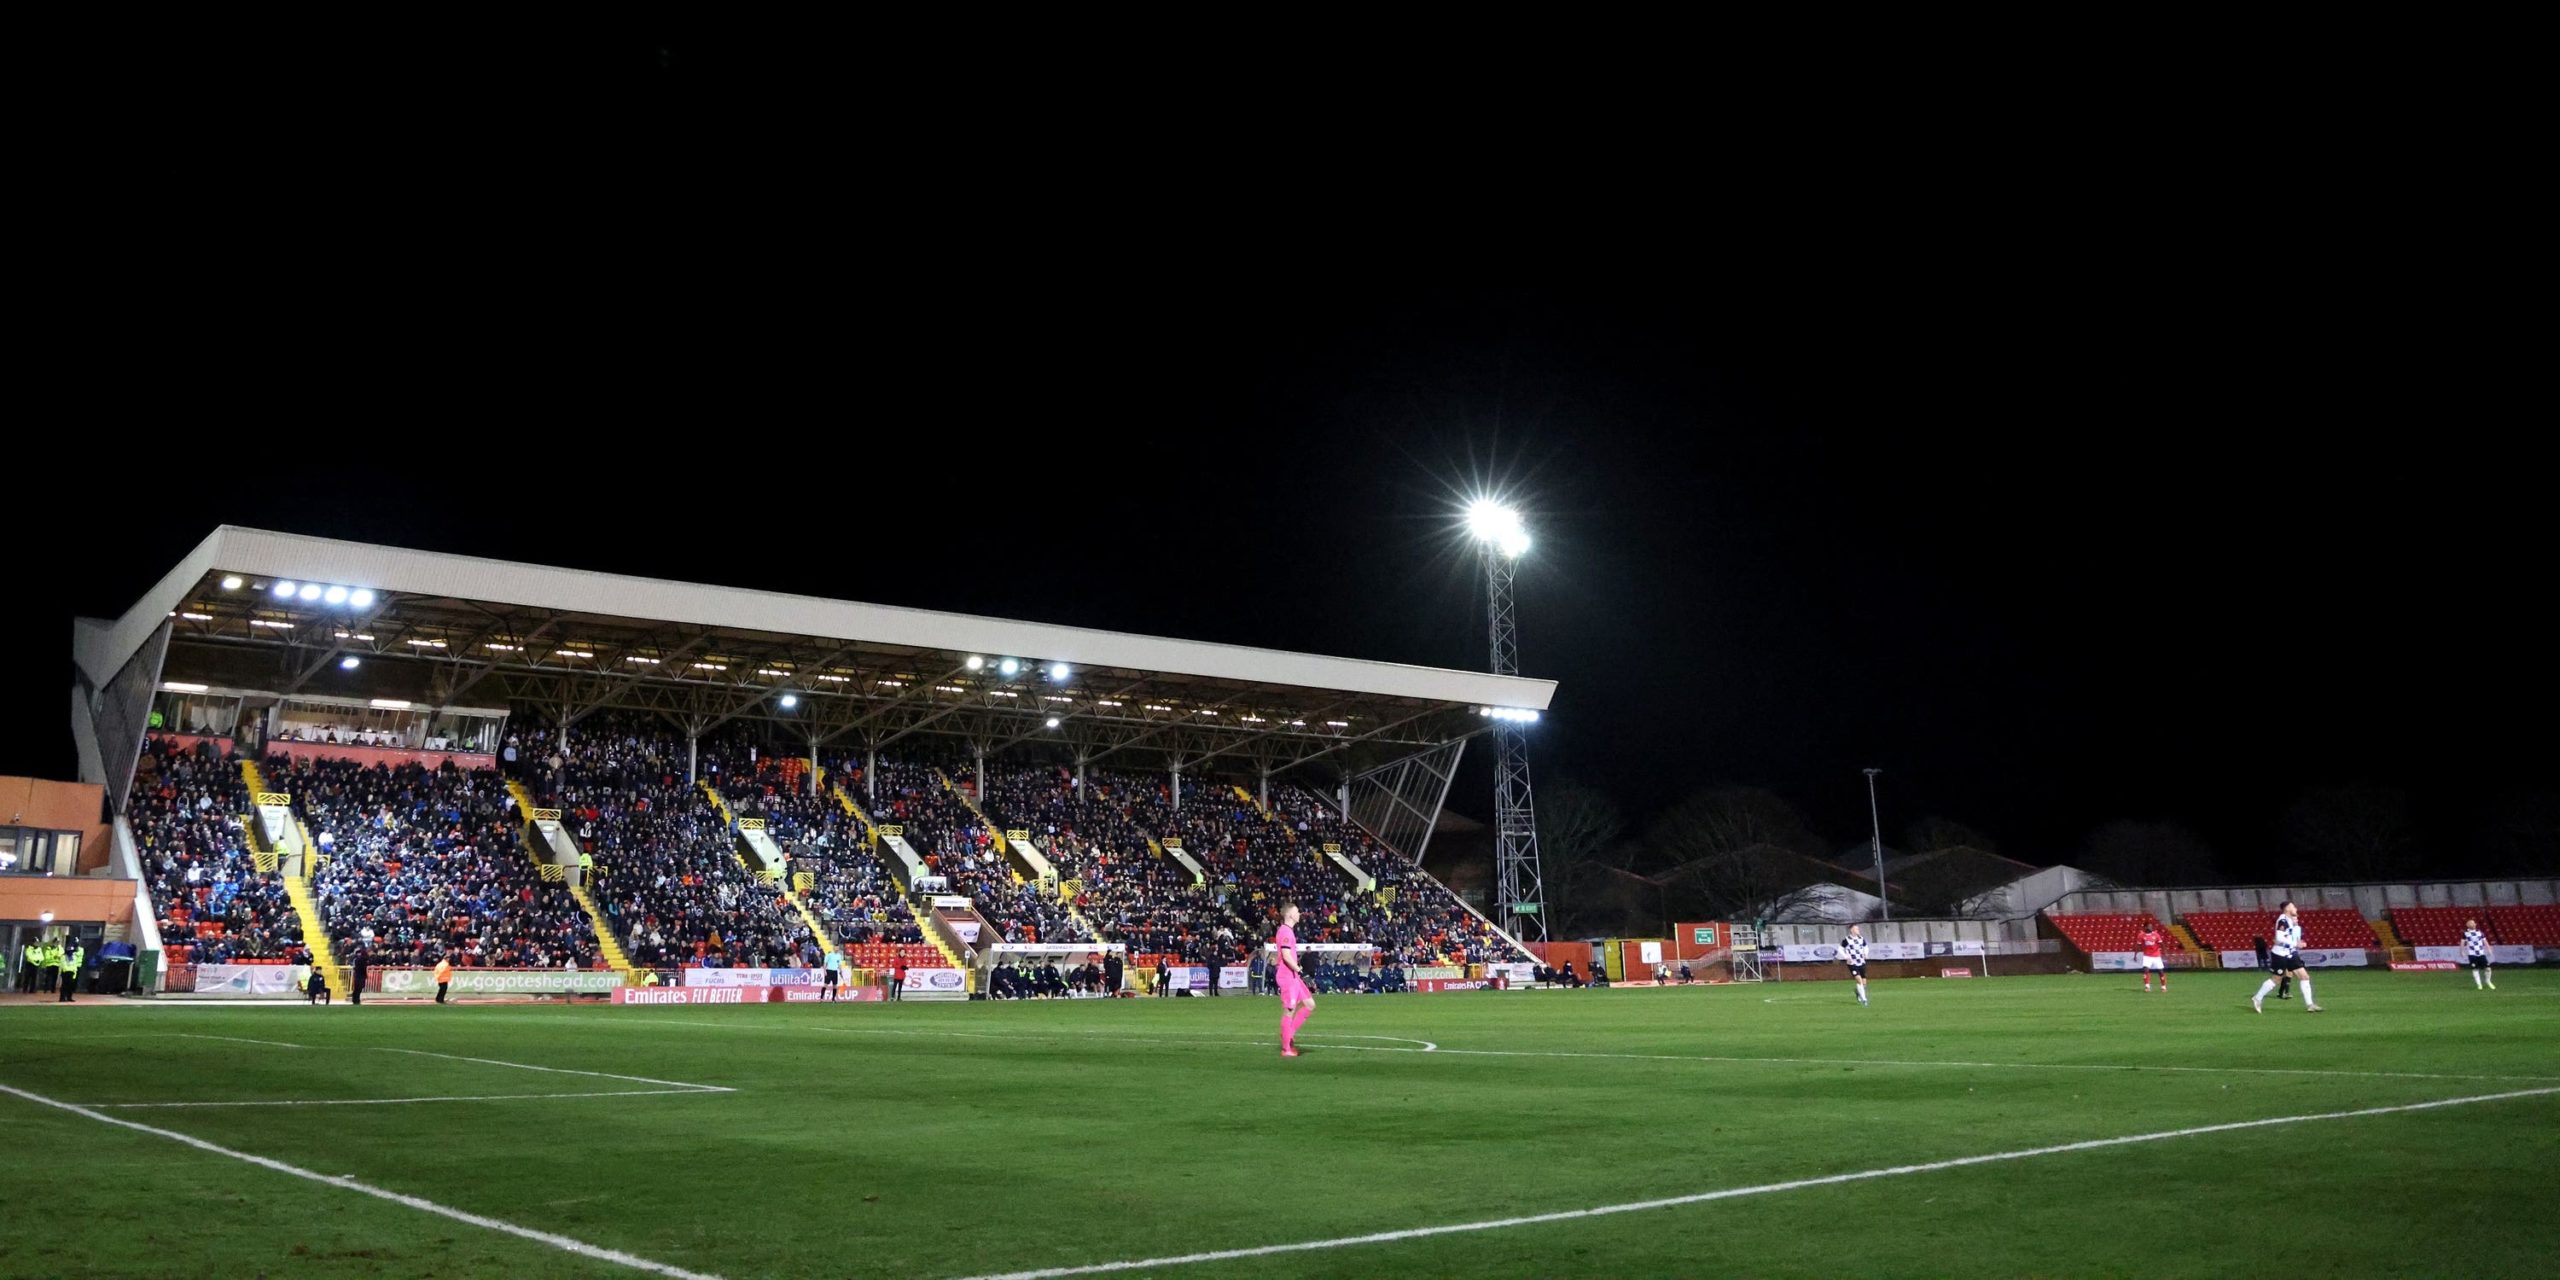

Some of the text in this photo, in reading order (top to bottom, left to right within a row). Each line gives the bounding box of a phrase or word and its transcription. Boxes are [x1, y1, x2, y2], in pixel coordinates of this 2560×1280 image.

[624, 988, 743, 1004] Emirates FLY BETTER
[787, 990, 822, 1001] Emirate
